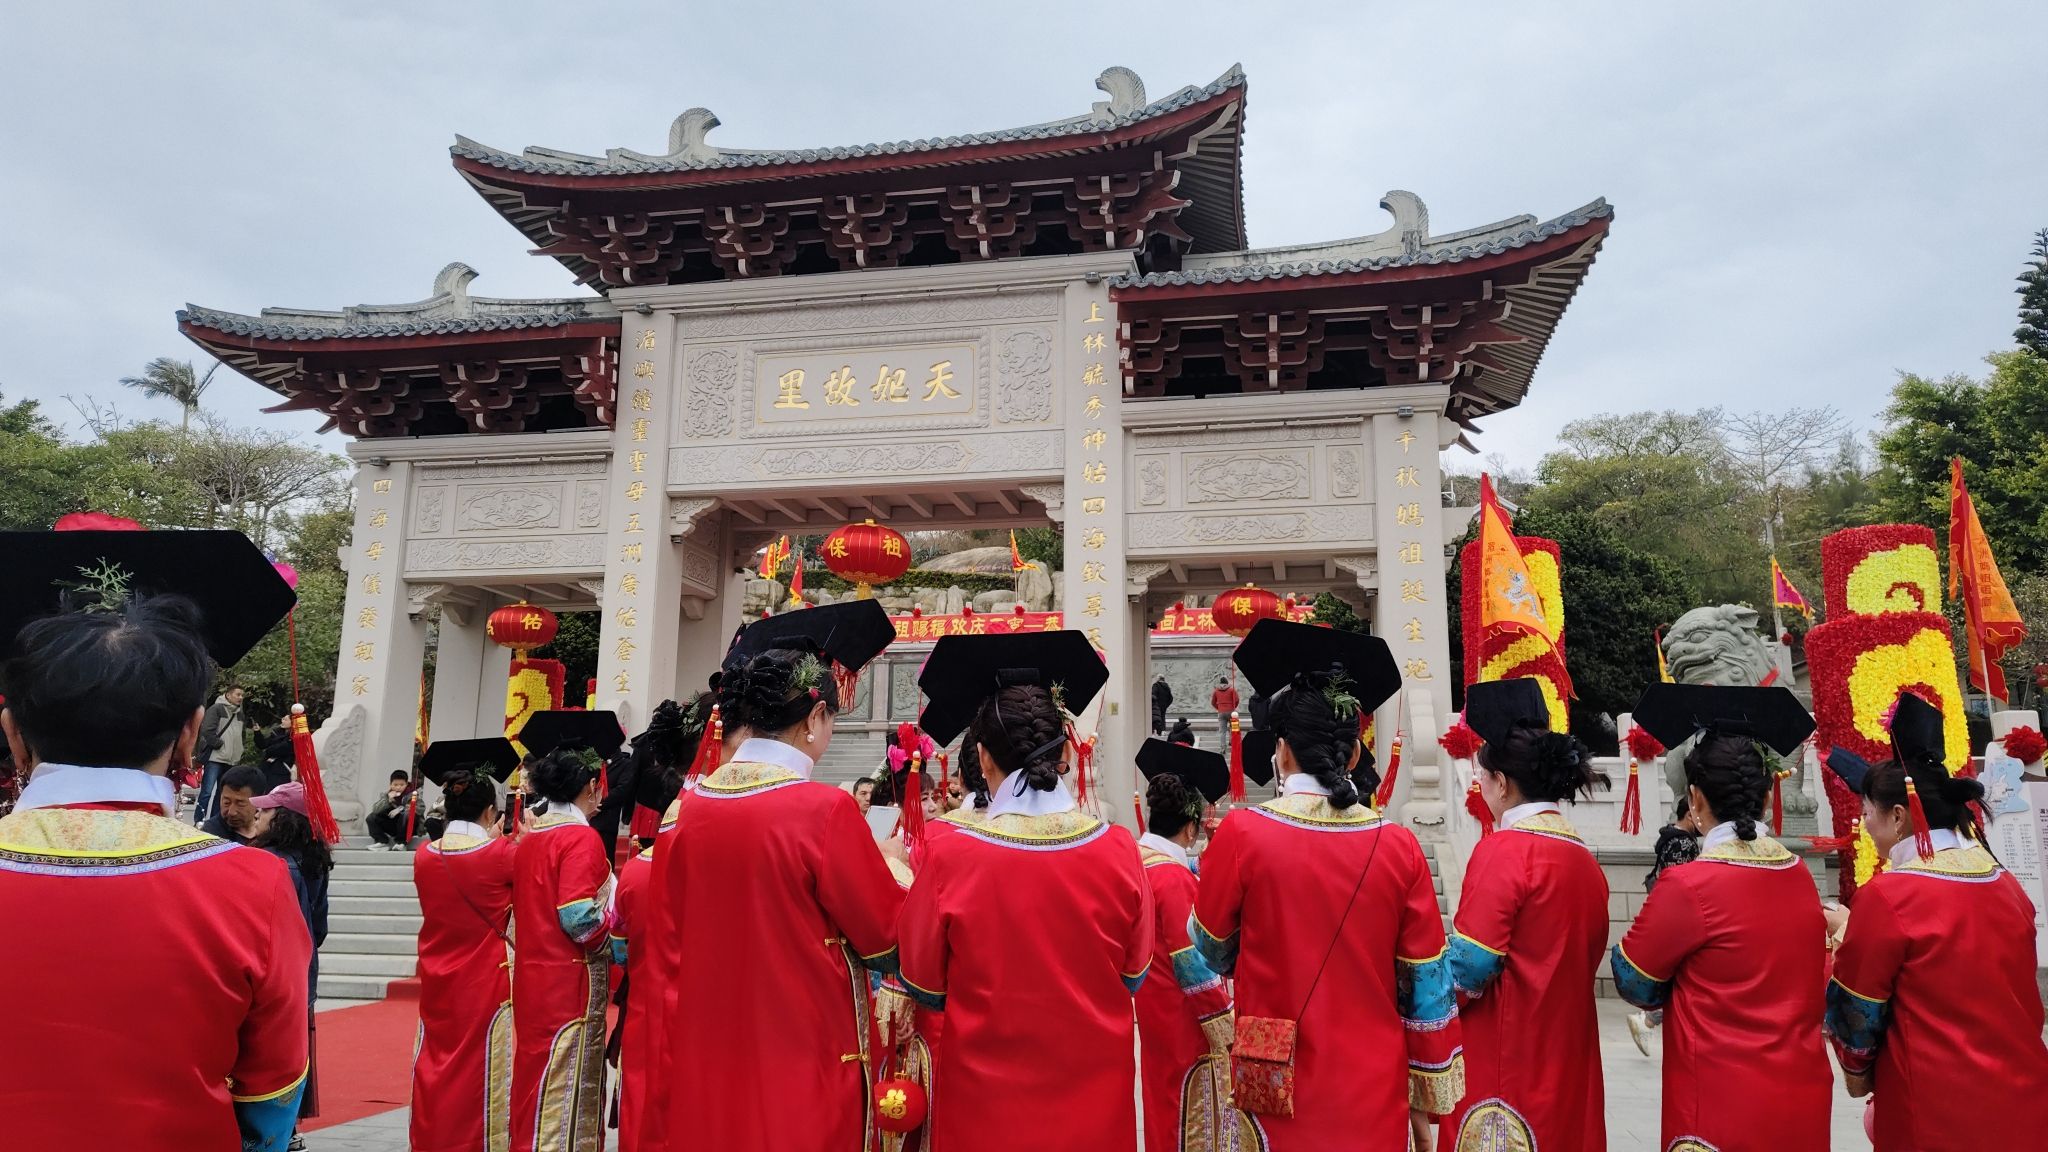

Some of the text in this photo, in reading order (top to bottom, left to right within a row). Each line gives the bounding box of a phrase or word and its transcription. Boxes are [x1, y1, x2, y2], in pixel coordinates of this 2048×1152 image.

[773, 359, 962, 410] 天妃故里
[1395, 429, 1434, 682] 千秋媽祖誕生地
[521, 613, 543, 630] 佑
